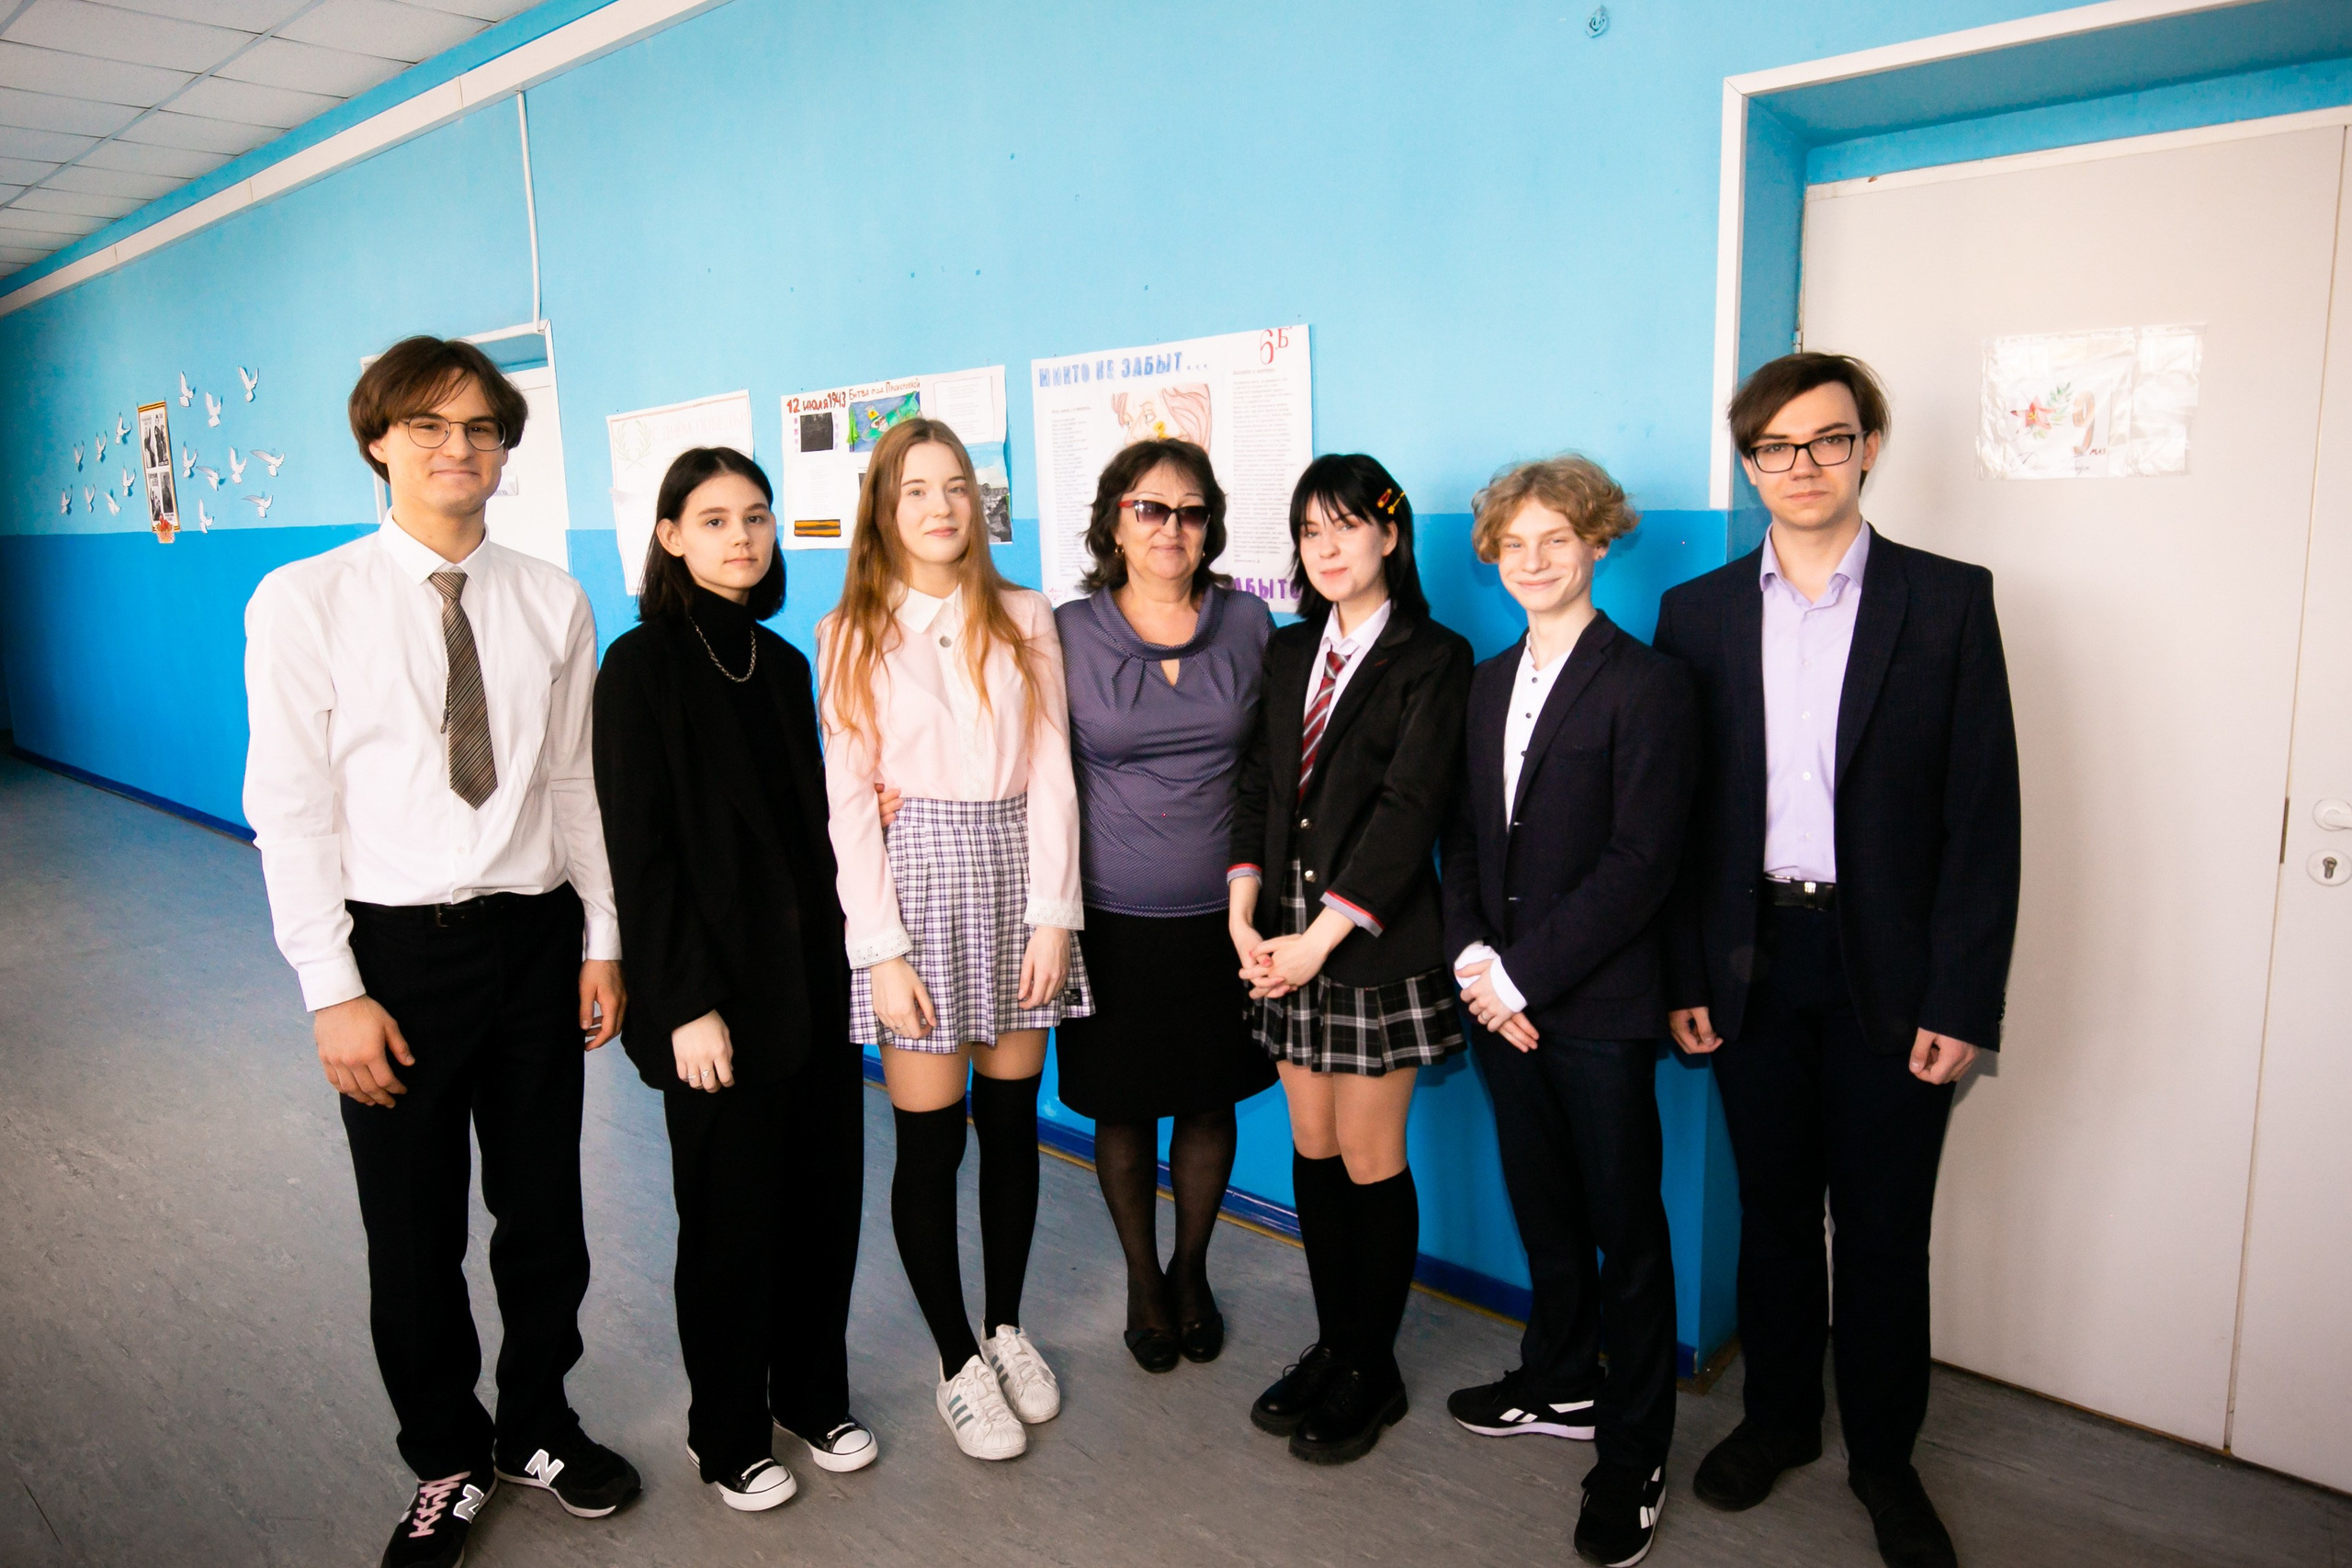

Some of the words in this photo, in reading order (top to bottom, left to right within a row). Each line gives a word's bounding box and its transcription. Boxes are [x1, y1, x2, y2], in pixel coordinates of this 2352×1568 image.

[1038, 362, 1091, 388] НИКТО
[1095, 358, 1114, 381] НЕ
[786, 397, 801, 413] 12
[827, 390, 846, 409] 1943
[525, 1449, 565, 1486] N
